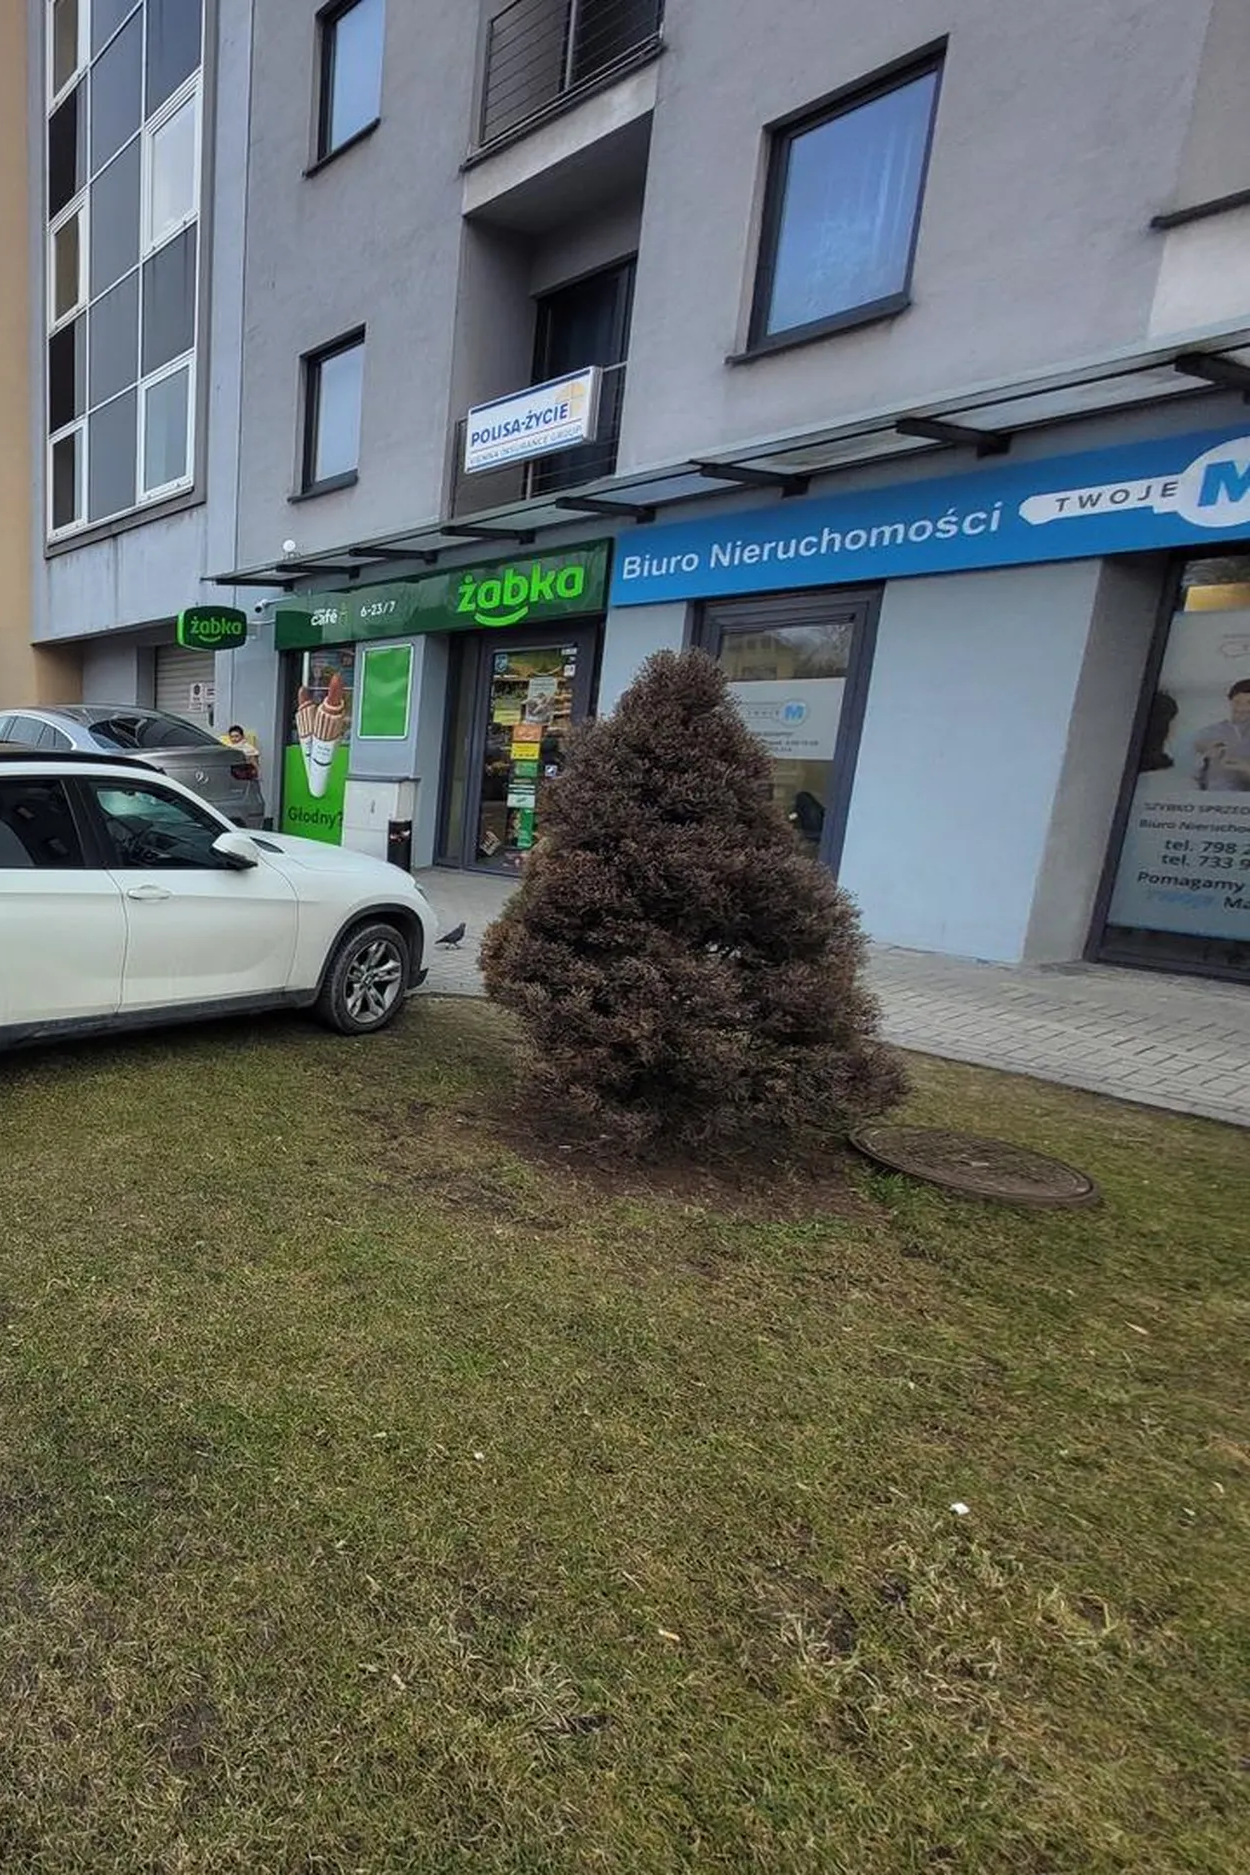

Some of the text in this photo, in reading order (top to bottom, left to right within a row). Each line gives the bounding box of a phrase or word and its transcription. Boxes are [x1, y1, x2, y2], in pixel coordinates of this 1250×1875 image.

[1055, 481, 1178, 512] TWOJE
[622, 501, 1003, 580] Biuro Nieruchomości
[456, 563, 584, 613] żabka
[190, 615, 242, 634] żabka
[1165, 840, 1194, 852] tel.
[1201, 841, 1238, 854] 798
[1161, 854, 1190, 867] tel.
[1198, 855, 1234, 869] 733
[1137, 871, 1245, 893] Pomagamy
